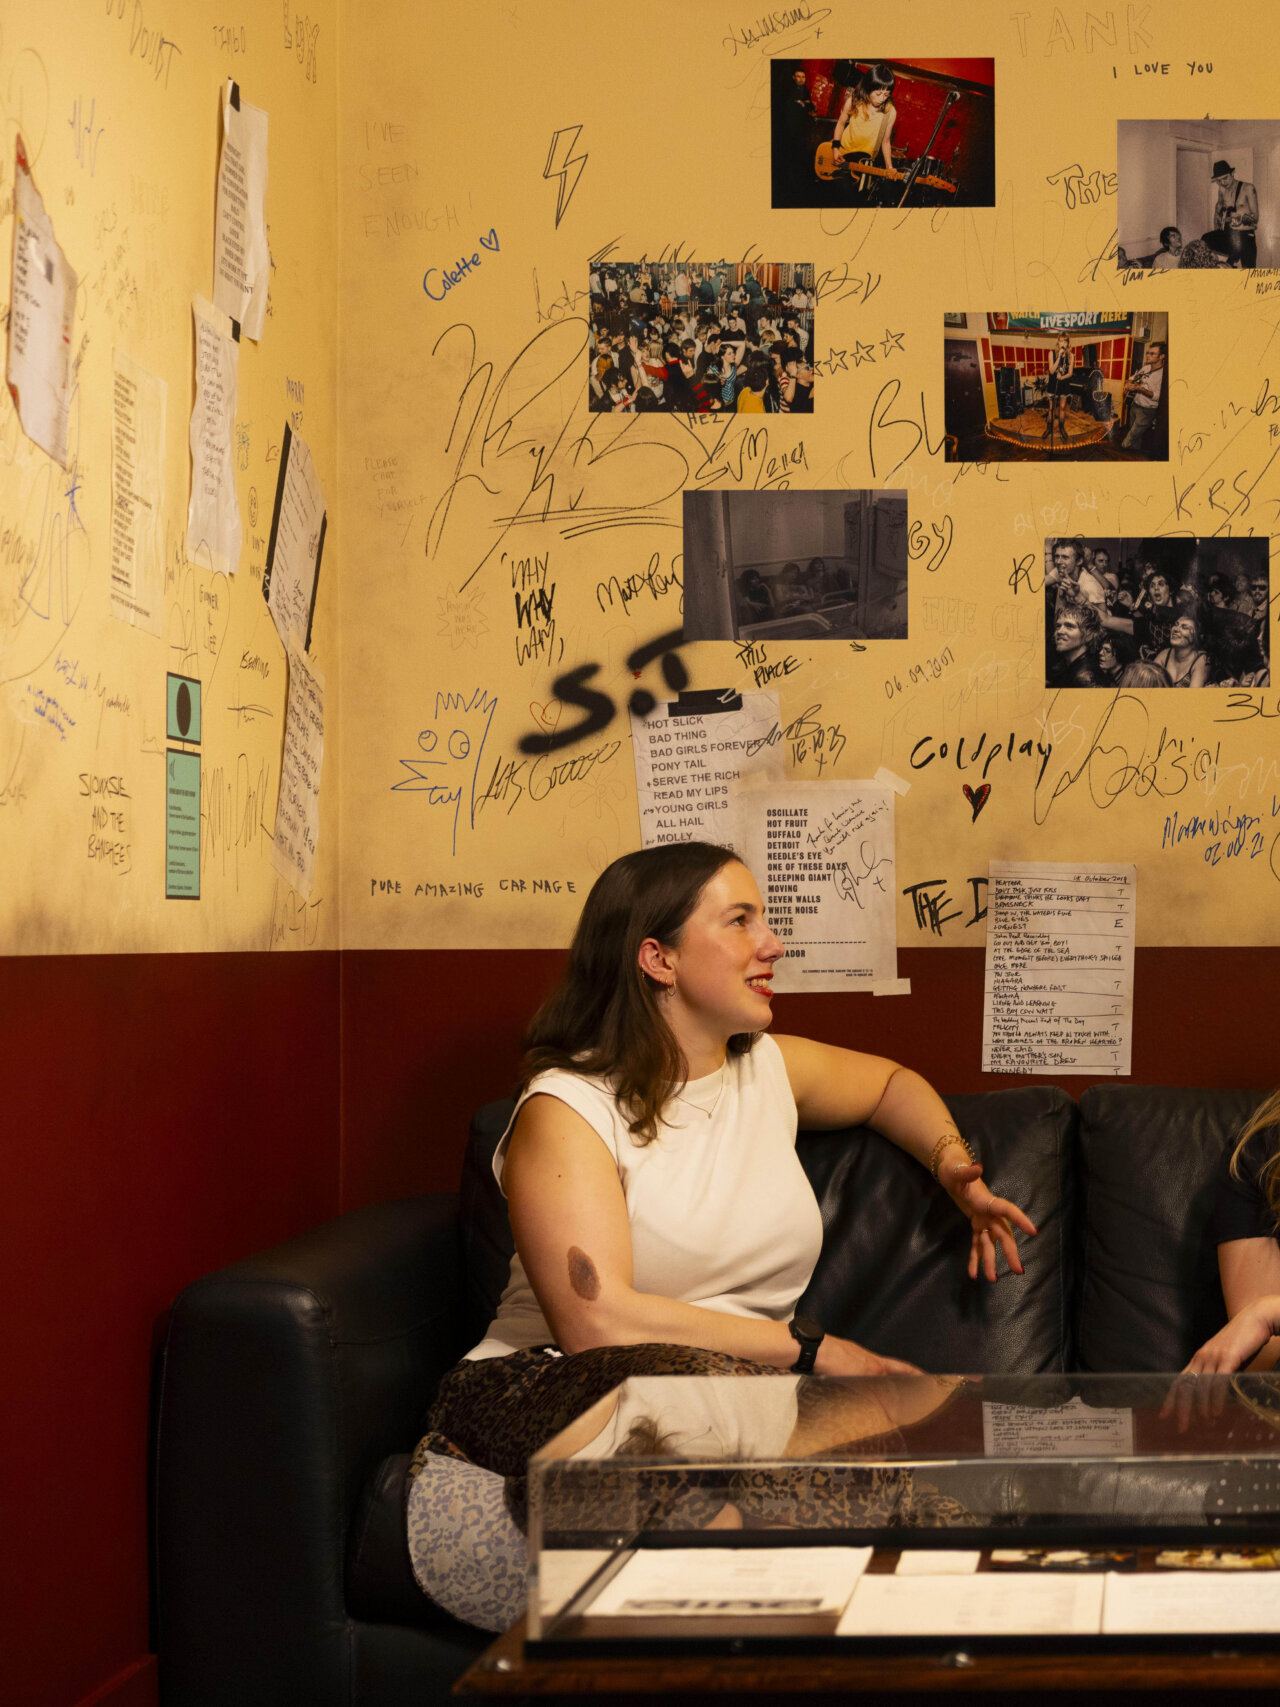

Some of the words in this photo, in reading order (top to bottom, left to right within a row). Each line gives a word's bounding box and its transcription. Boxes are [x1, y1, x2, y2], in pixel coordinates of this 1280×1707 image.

[1009, 4, 1153, 57] TANK
[1113, 66, 1117, 79] I
[1135, 62, 1170, 75] LOVE
[1187, 61, 1213, 76] YOU
[424, 253, 481, 301] Colette
[647, 719, 668, 729] HOT
[672, 716, 703, 726] SLICK
[649, 733, 671, 744] BAD
[674, 730, 707, 741] THING
[650, 747, 672, 758] BAD
[677, 745, 707, 756] GIRLS
[710, 740, 761, 752] FOREVER
[651, 761, 681, 772] PONY
[684, 760, 707, 769] TAIL
[910, 732, 1052, 788] Coldplay
[652, 775, 688, 787] SERVE
[691, 774, 711, 783] THE
[714, 771, 740, 781] RICH
[653, 789, 683, 800] READ
[687, 788, 702, 798] MY
[705, 785, 728, 796] LIPS
[655, 803, 693, 814] YOUNG
[697, 800, 728, 811] GIRLS
[656, 818, 676, 828] ALL
[680, 816, 704, 826] HAIL
[657, 832, 693, 843] MOLLY
[767, 852, 804, 860] NEEDLE'S
[807, 852, 822, 860] EYE
[768, 874, 805, 882] SLEEPING
[371, 878, 402, 897] PURE
[414, 879, 485, 898] AMAZING
